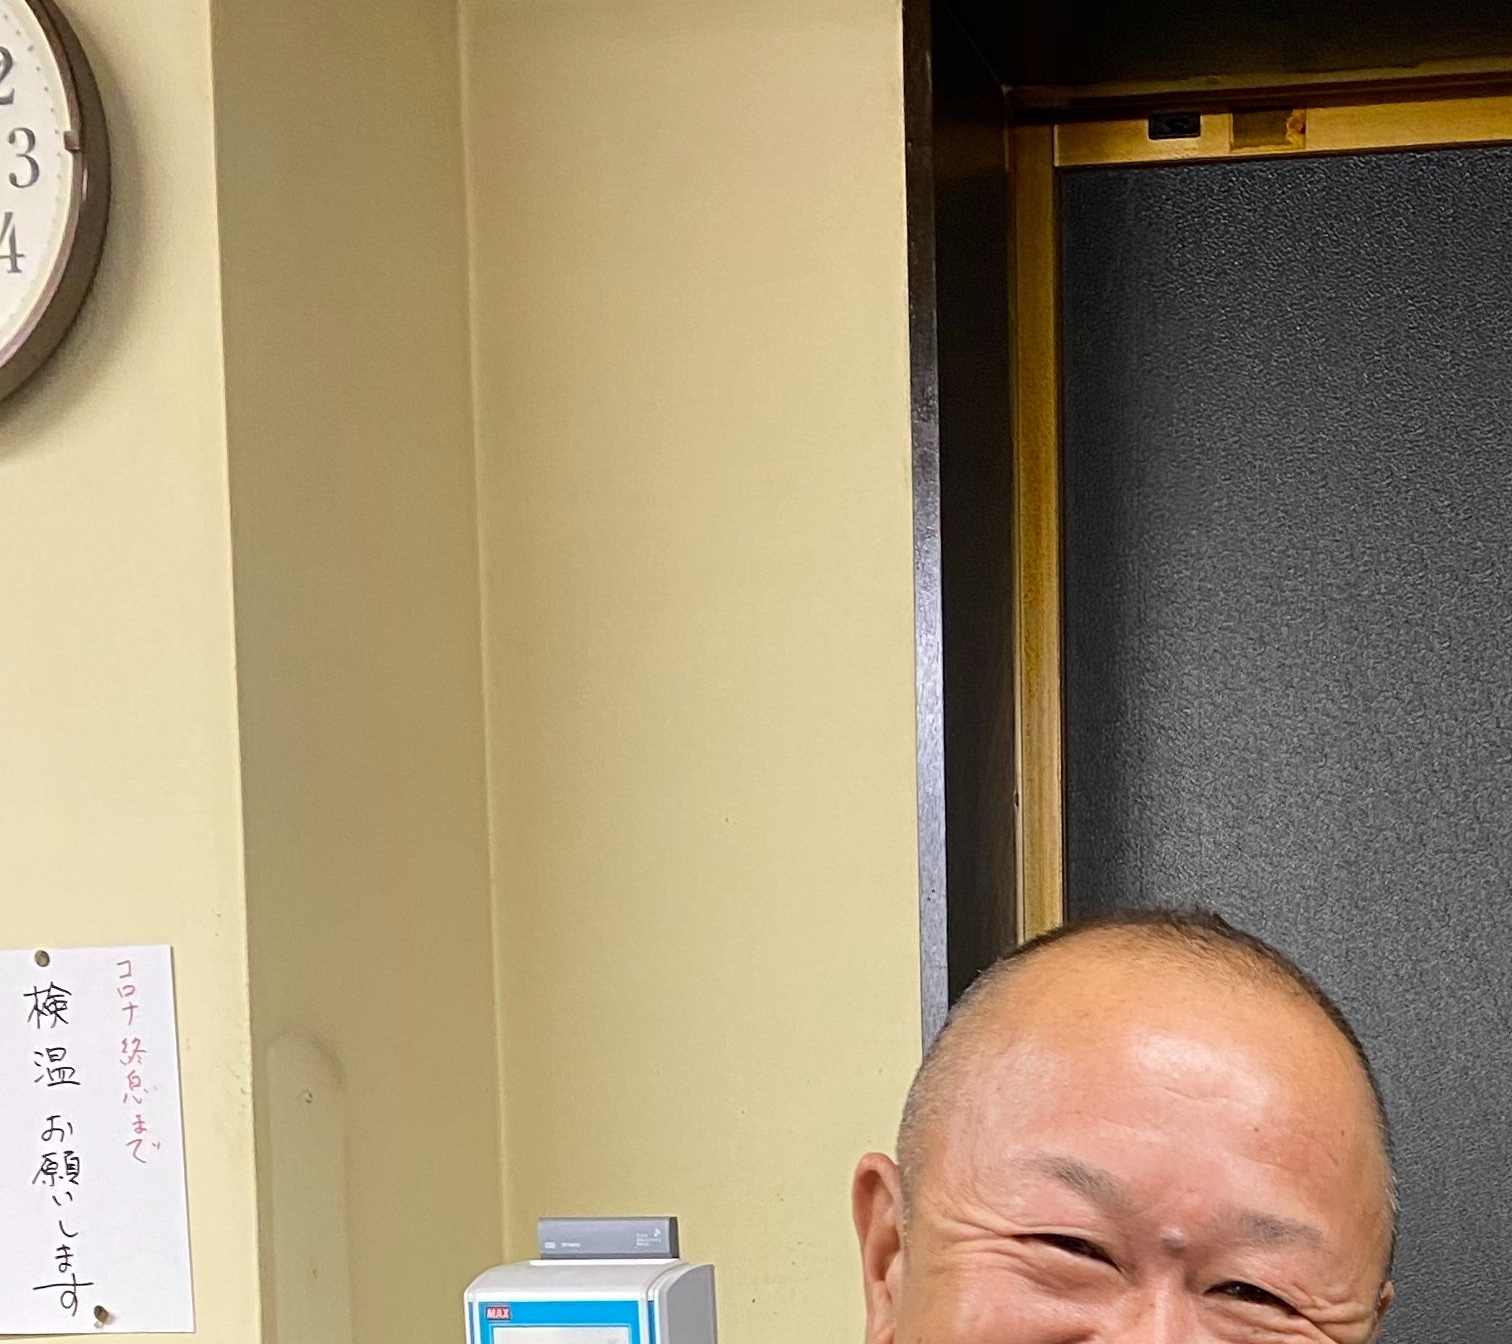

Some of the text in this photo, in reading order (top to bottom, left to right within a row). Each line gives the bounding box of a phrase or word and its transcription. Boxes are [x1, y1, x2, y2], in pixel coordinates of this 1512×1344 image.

[8, 127, 40, 189] 3
[0, 211, 25, 273] 4
[23, 982, 94, 1317] 検温お願いします
[487, 1307, 511, 1320] MAX
